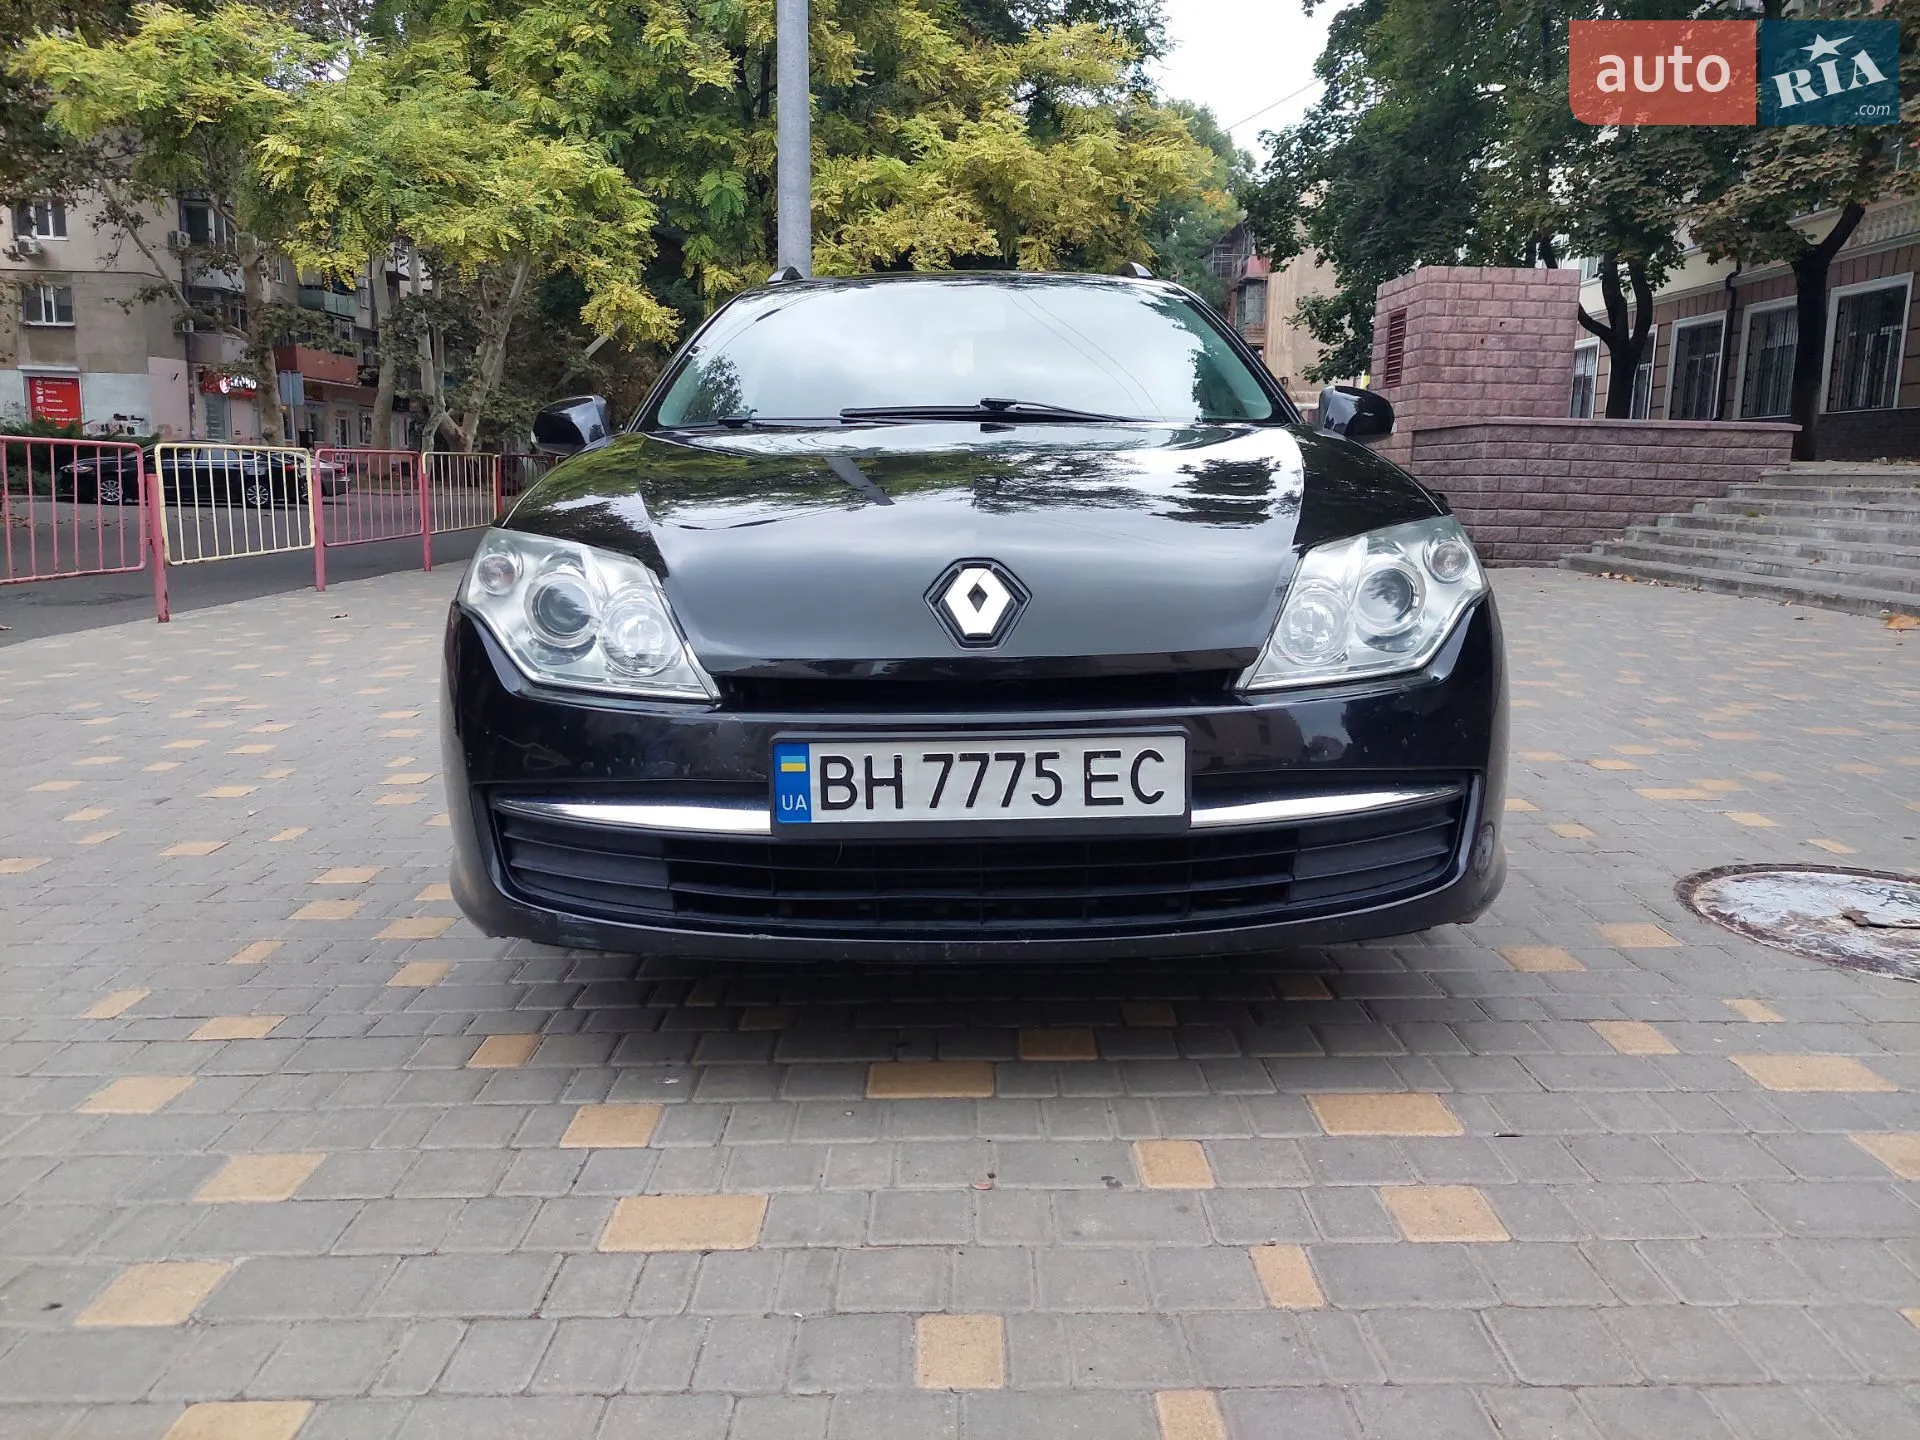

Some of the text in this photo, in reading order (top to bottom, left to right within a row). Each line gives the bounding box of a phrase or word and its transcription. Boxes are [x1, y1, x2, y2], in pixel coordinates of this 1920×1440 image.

[819, 748, 1165, 811] BH 7775 EC
[782, 795, 808, 812] UA
